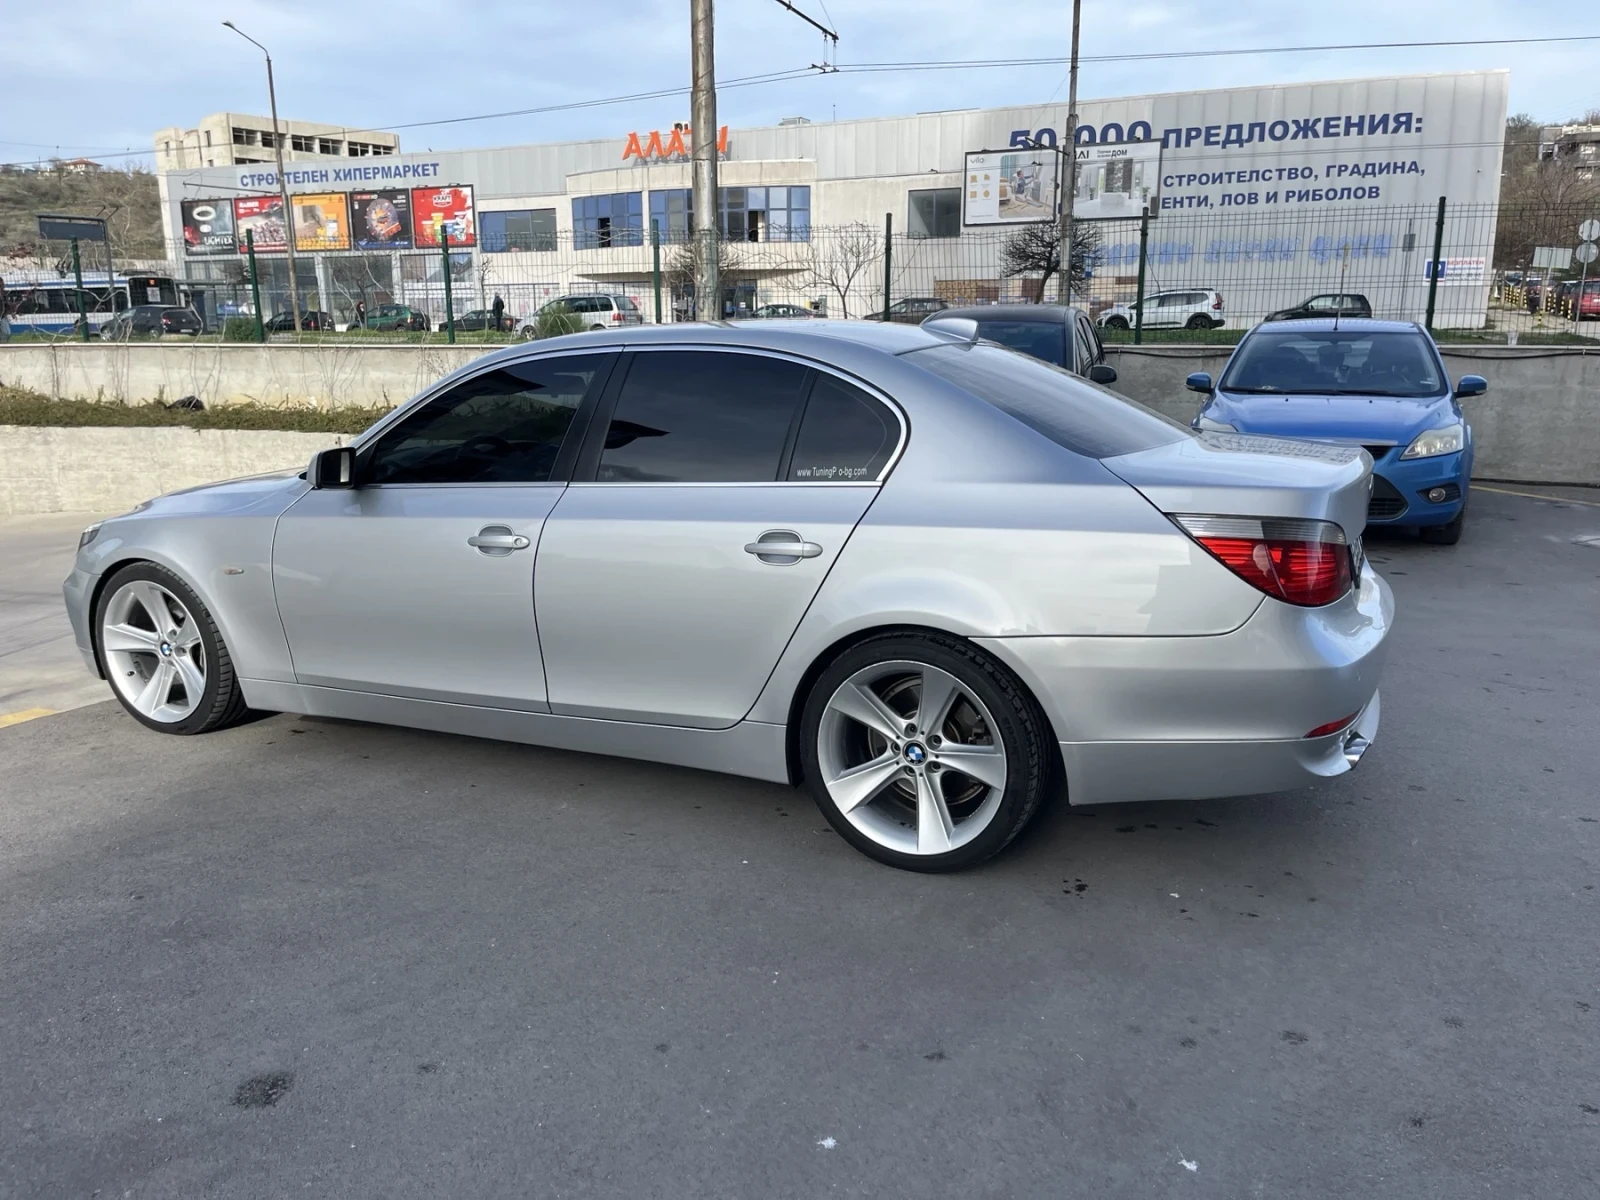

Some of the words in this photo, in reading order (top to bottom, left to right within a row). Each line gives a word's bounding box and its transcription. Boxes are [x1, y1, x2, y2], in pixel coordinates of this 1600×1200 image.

[622, 125, 728, 160] АЛАИ
[1163, 112, 1423, 150] ПРЕДЛОЖЕНИЯ:
[1111, 149, 1128, 158] ДОМ
[333, 162, 440, 182] ХИПЕРМАРКЕТ
[1163, 166, 1319, 188] СТРОИТЕЛСТВО,
[1325, 160, 1426, 179] ГРАДИНА,
[1161, 195, 1215, 210] ЕНТИ,
[1219, 192, 1259, 207] ЛОВ
[1265, 190, 1279, 204] И
[1285, 185, 1381, 203] РИБОЛОВ
